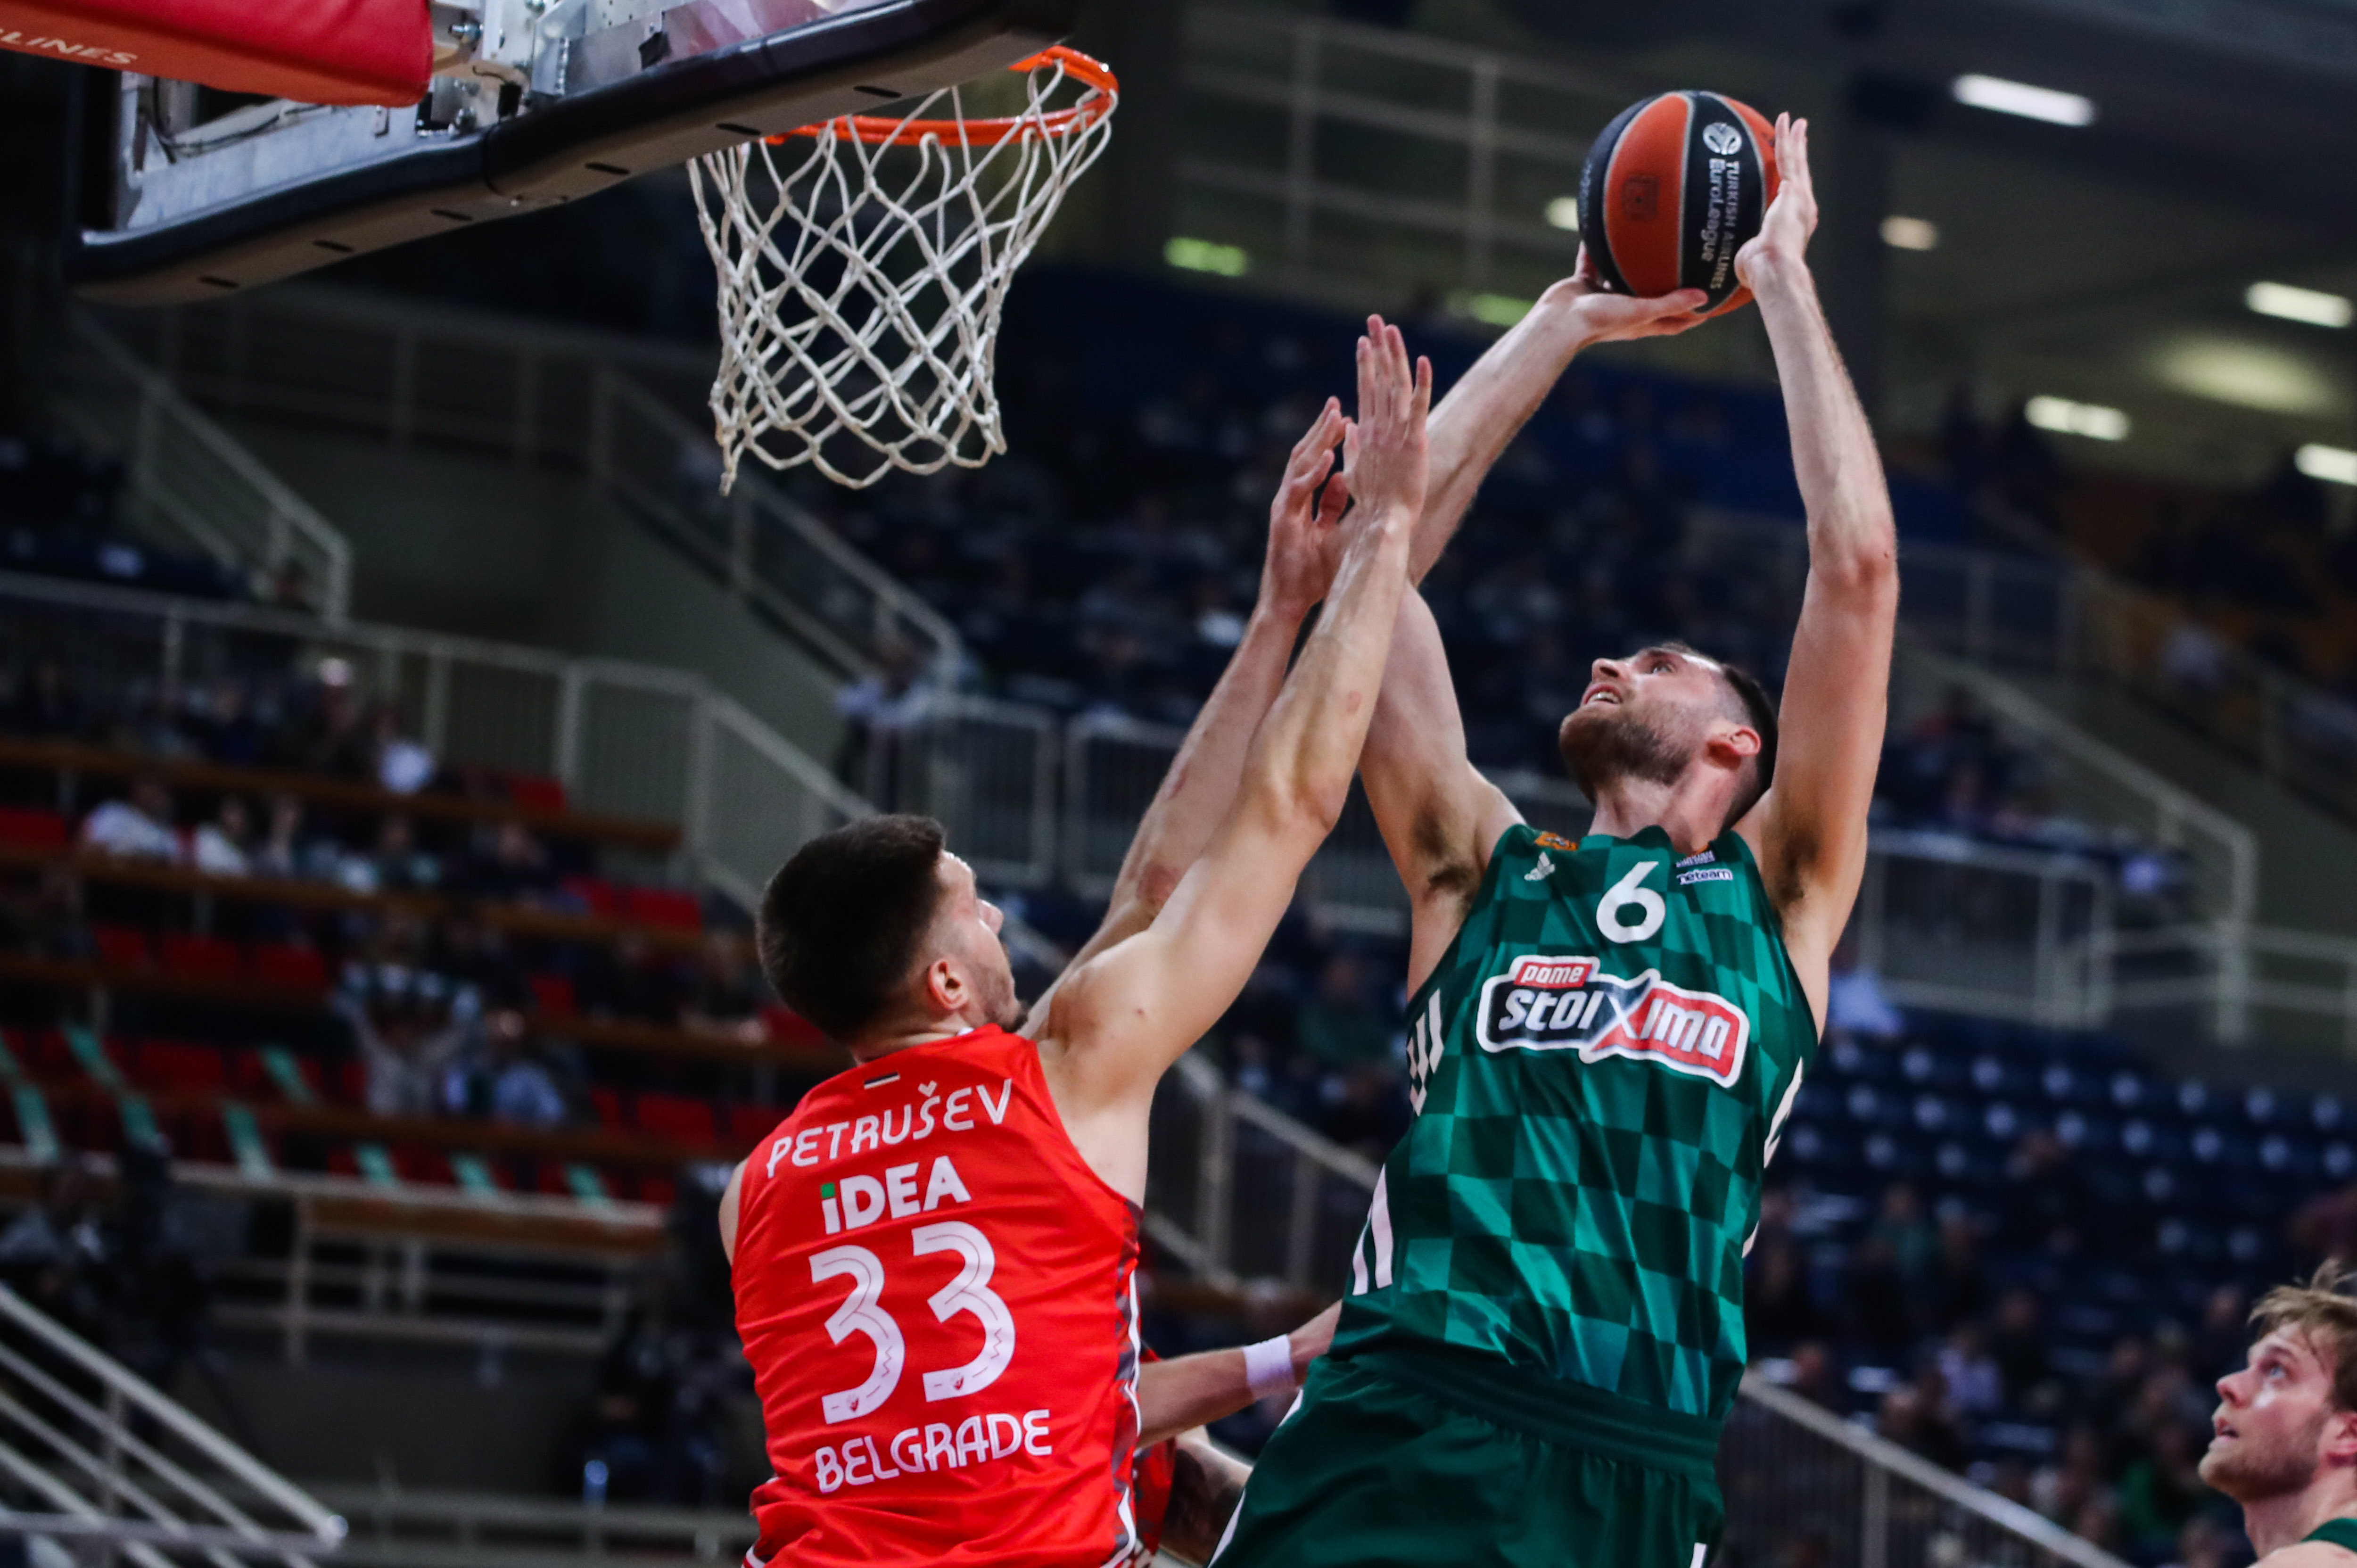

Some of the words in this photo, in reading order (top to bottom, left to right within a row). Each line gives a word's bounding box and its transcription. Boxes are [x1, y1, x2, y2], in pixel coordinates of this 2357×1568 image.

[0, 28, 138, 64] LINES
[1725, 160, 1740, 227] TURKISH
[1710, 231, 1735, 290] AIRLINES
[1596, 861, 1666, 943] 6
[1520, 965, 1585, 984] pame
[766, 1078, 1012, 1179] PETRUŠEV
[808, 1221, 1016, 1424] 33
[815, 1409, 1053, 1494] BELGRADE
